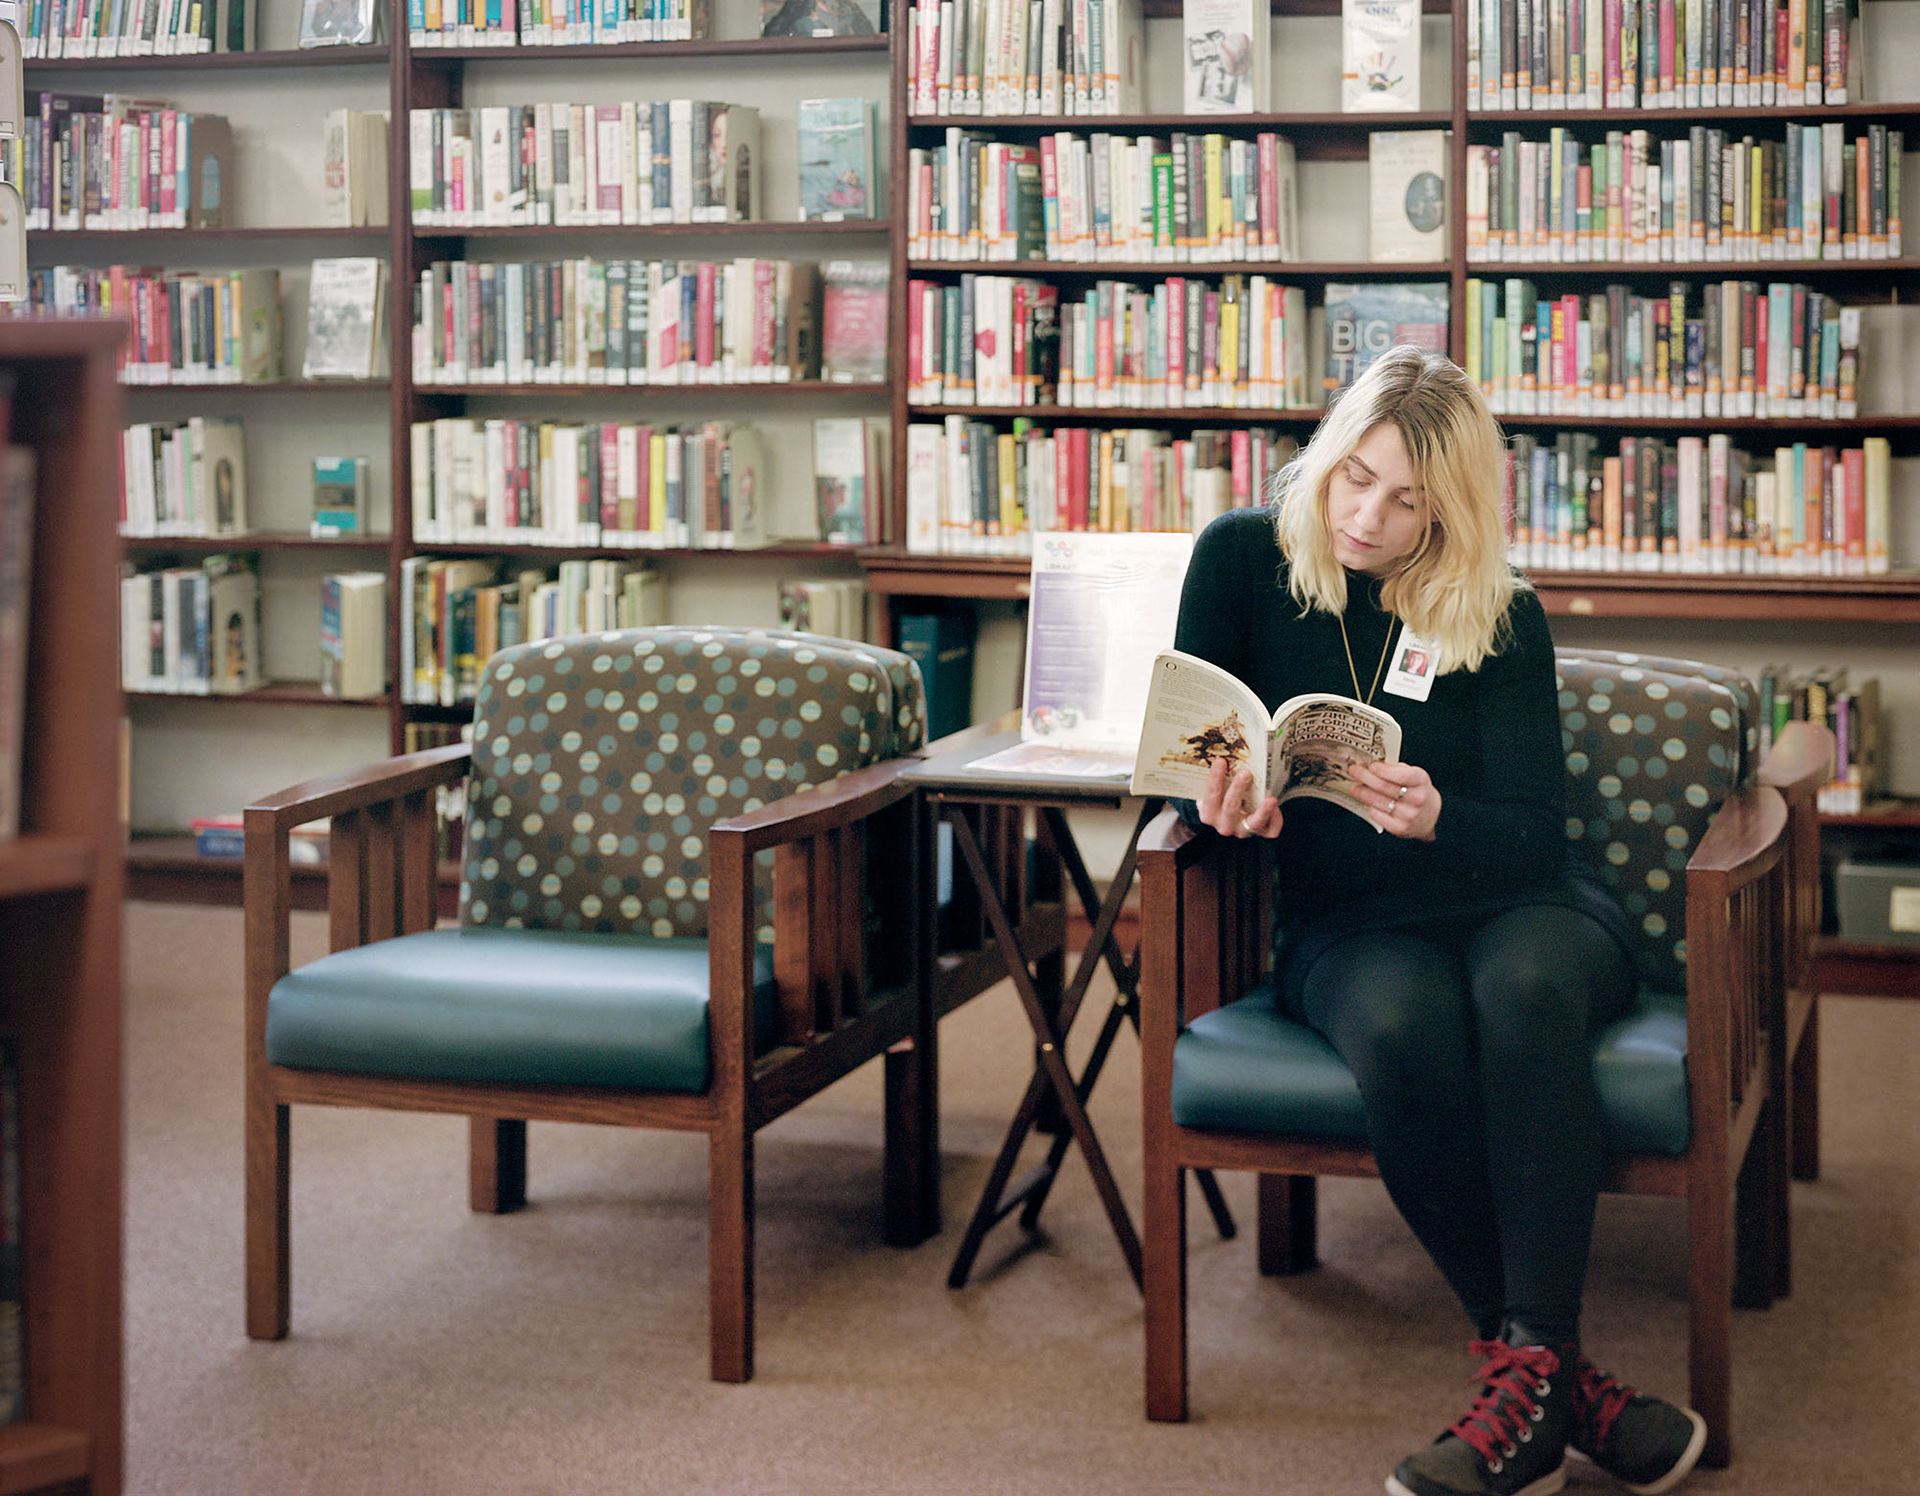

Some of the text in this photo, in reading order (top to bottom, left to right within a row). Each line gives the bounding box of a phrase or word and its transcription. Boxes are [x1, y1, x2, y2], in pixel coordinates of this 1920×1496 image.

[1332, 320, 1390, 353] BIG
[1322, 711, 1372, 729] ARE ALL
[1325, 733, 1379, 756] NORTON
